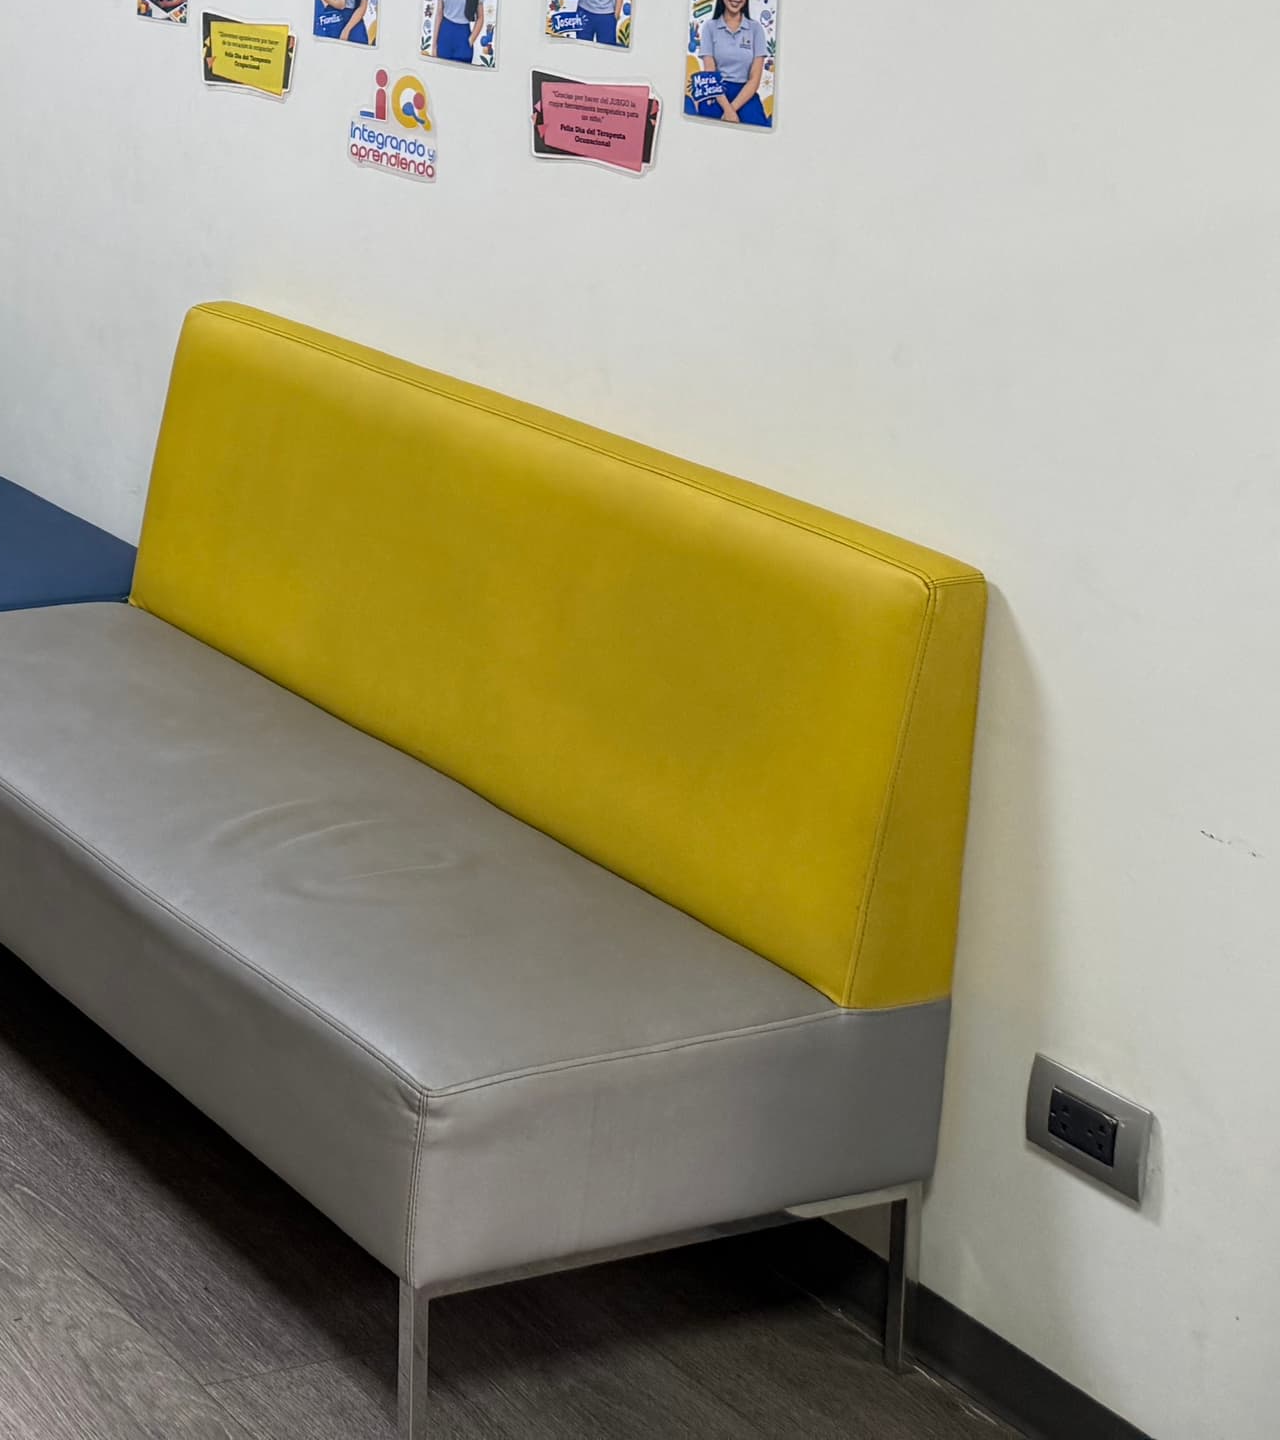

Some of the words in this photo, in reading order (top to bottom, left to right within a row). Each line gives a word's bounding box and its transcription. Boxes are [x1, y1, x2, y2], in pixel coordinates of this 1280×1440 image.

[555, 14, 582, 30] Joseph
[351, 144, 435, 178] aprendiendo
[427, 148, 436, 163] y
